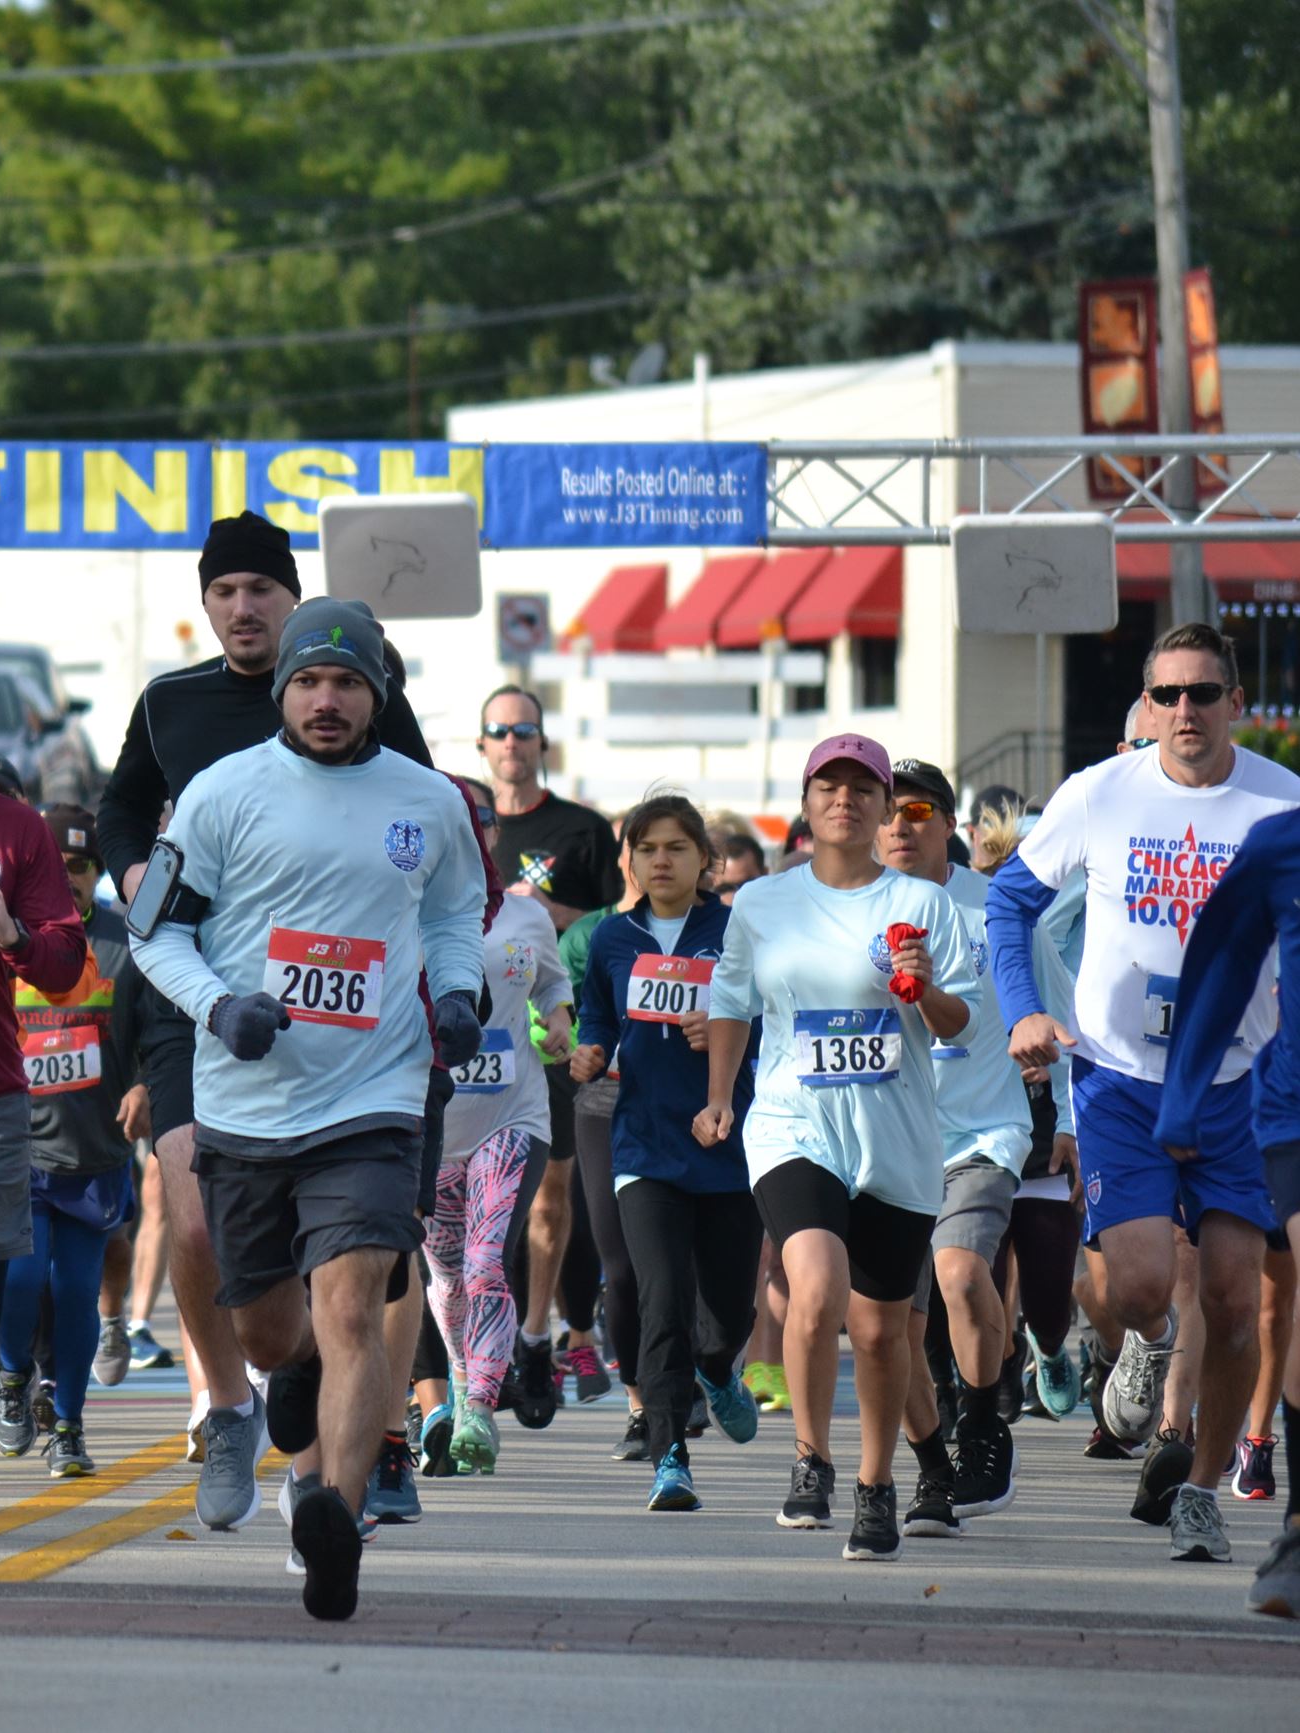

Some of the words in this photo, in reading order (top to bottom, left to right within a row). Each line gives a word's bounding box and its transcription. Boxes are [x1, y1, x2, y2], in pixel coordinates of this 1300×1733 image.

[561, 465, 612, 497] Results
[616, 465, 664, 497] Posted
[668, 465, 715, 497] Online
[562, 501, 743, 530] www.J3Timing.com
[1129, 836, 1165, 850] BANK
[1168, 839, 1185, 852] OF
[1127, 848, 1228, 881] CHICAG
[308, 942, 329, 955] J3
[658, 962, 673, 971] J3
[279, 964, 366, 1014] 2036
[638, 979, 698, 1014] 2001
[827, 1016, 847, 1027] J3
[31, 1051, 88, 1086] 2031
[812, 1036, 886, 1073] 1368
